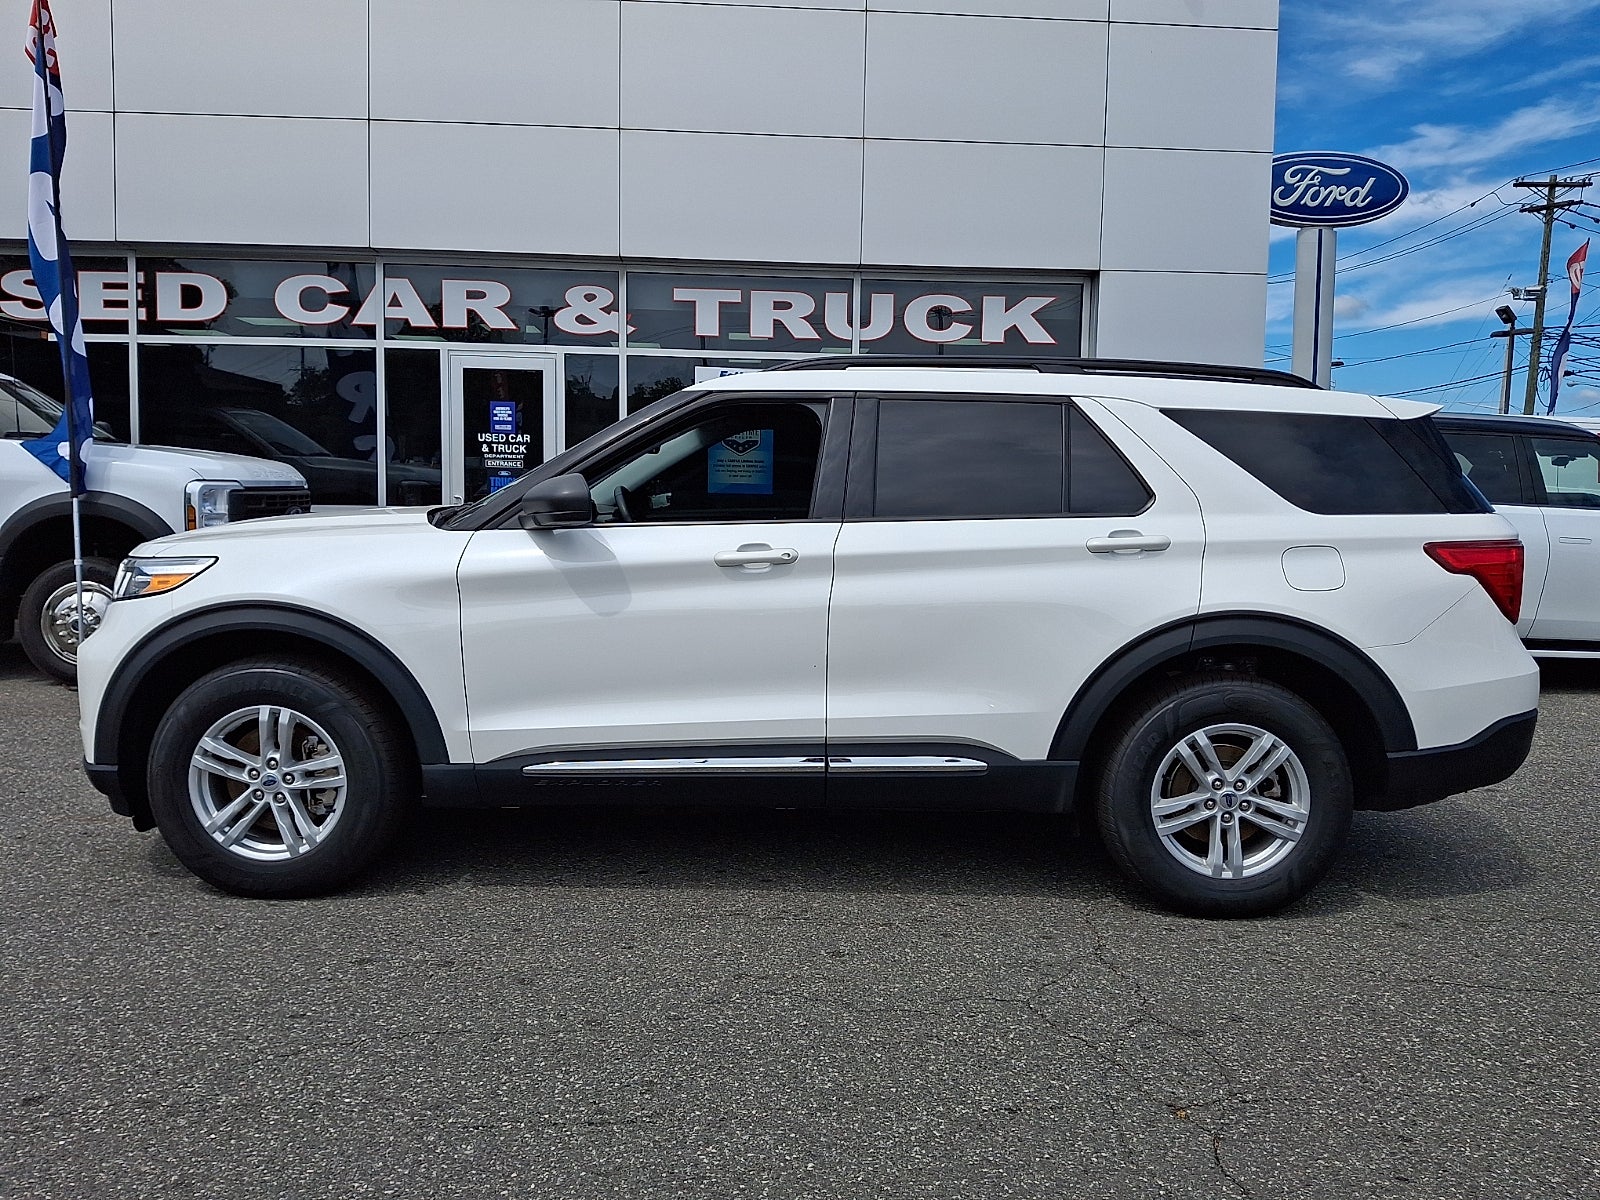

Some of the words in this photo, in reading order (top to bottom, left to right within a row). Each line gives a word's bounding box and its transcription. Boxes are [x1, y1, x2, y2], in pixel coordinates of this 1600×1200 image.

[1273, 164, 1377, 208] Ford
[273, 274, 518, 330] CAR
[554, 284, 636, 336] &
[673, 287, 1058, 346] TRUCK
[478, 433, 507, 442] USED
[509, 434, 531, 443] CAR
[482, 444, 489, 452] &
[491, 444, 527, 453] TRUCK
